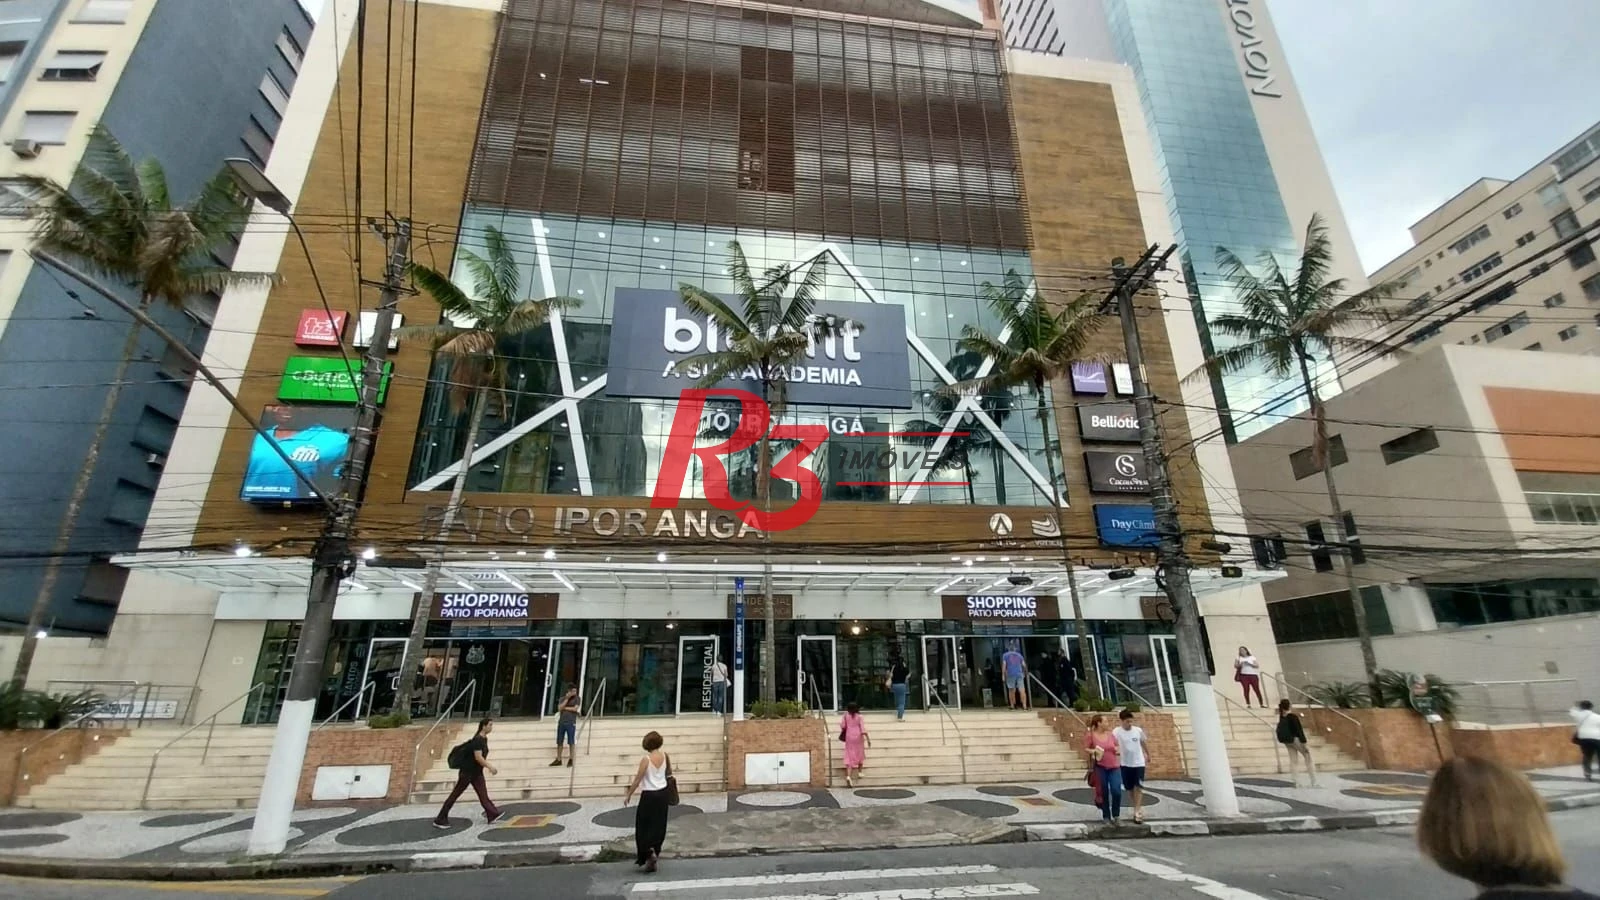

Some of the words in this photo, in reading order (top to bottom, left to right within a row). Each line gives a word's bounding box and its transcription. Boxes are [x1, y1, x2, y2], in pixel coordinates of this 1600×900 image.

[554, 506, 764, 538] IPORANGA
[442, 593, 529, 608] SHOPPING
[967, 596, 1037, 609] SHOPPING
[440, 607, 471, 618] PÁTIO
[474, 608, 529, 618] IPORANGA
[968, 608, 992, 618] PÁTIO
[993, 609, 1037, 618] IPORANGA
[702, 643, 714, 709] RESIDENCIAL
